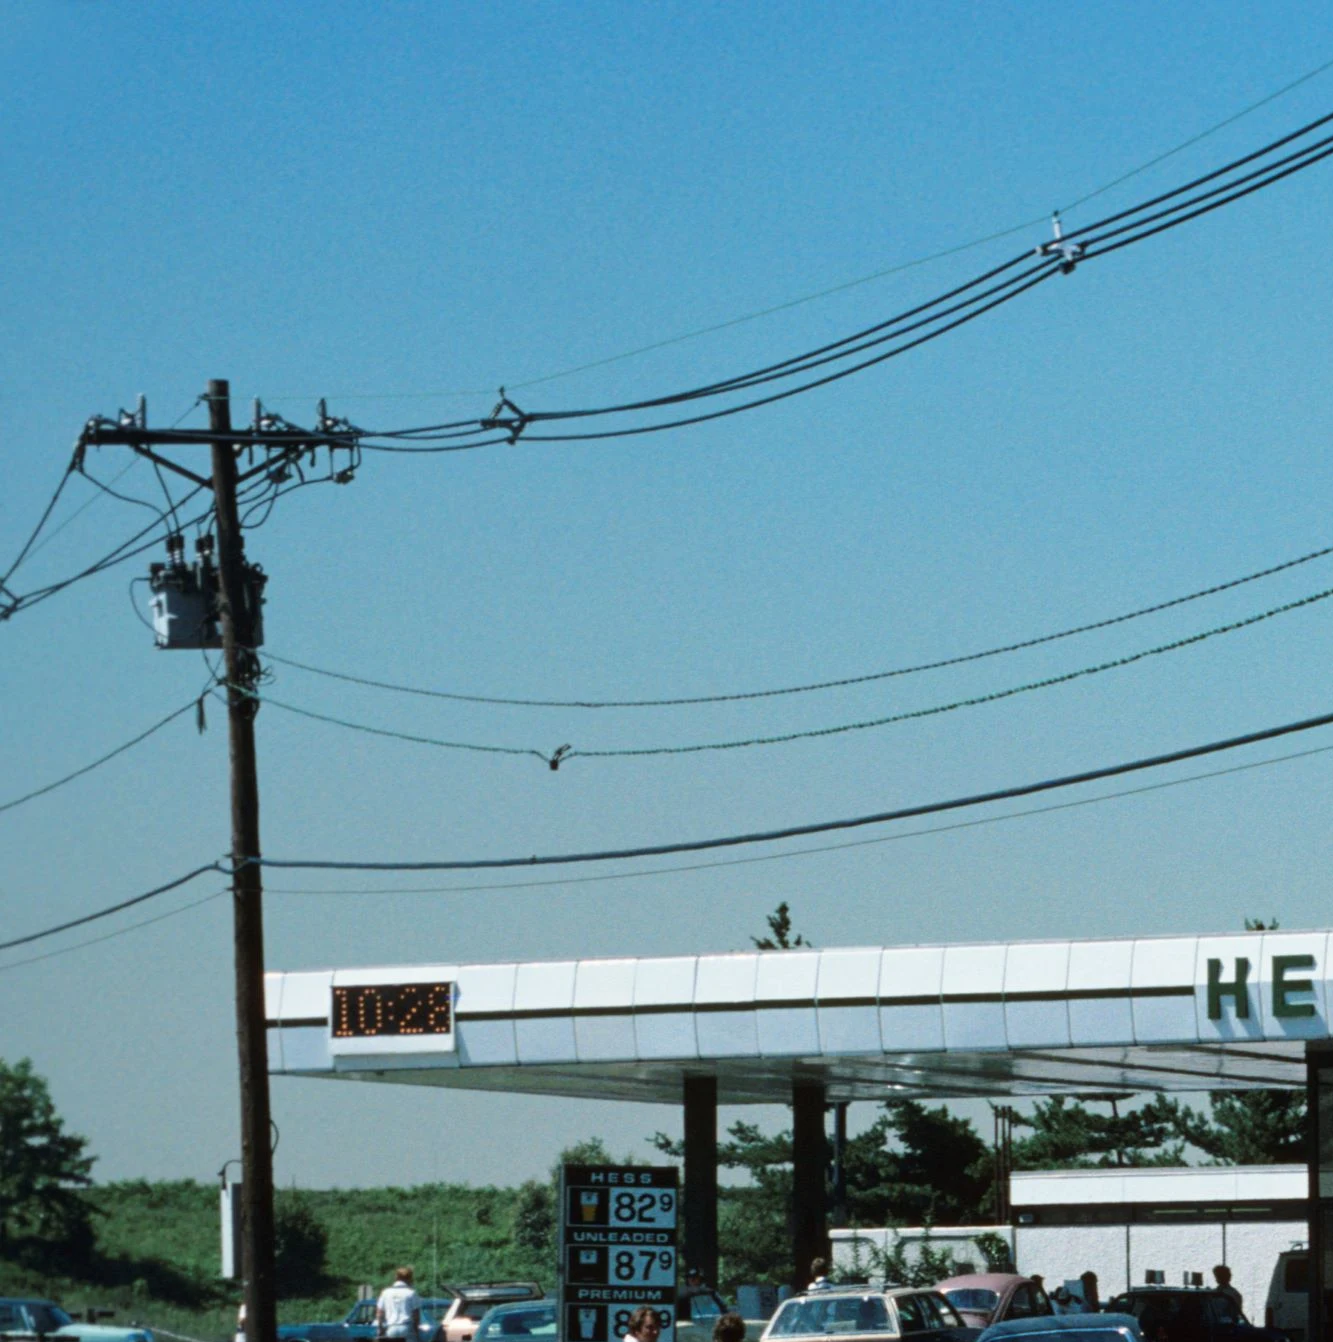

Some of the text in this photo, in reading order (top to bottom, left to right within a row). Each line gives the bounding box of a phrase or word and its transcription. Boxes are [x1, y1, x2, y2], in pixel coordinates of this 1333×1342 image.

[590, 1172, 653, 1184] HESS
[573, 1231, 669, 1243] UNLEADED
[578, 1289, 662, 1300] PREMIUM
[613, 1309, 672, 1339] 89
